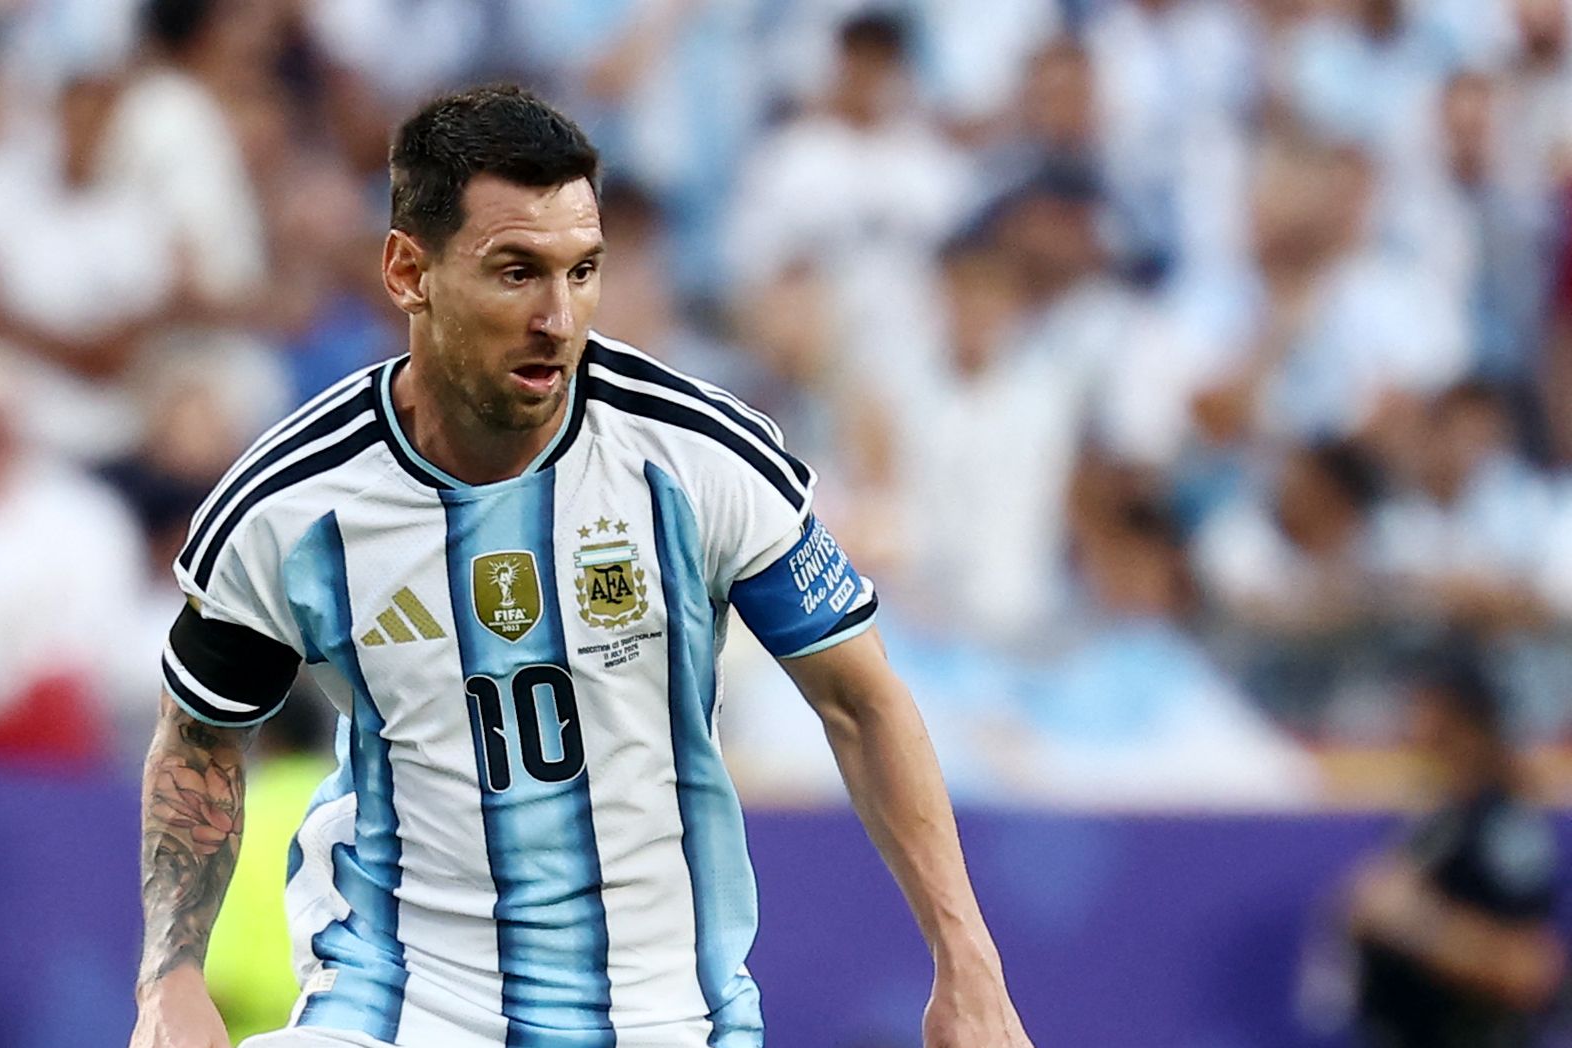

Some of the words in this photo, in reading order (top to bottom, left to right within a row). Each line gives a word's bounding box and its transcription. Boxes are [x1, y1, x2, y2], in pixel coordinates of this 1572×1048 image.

[793, 527, 836, 592] UNITES
[590, 565, 633, 604] AFA
[800, 586, 827, 615] the
[833, 582, 853, 607] FIFA
[494, 608, 525, 621] FIFA
[464, 664, 586, 792] 10
